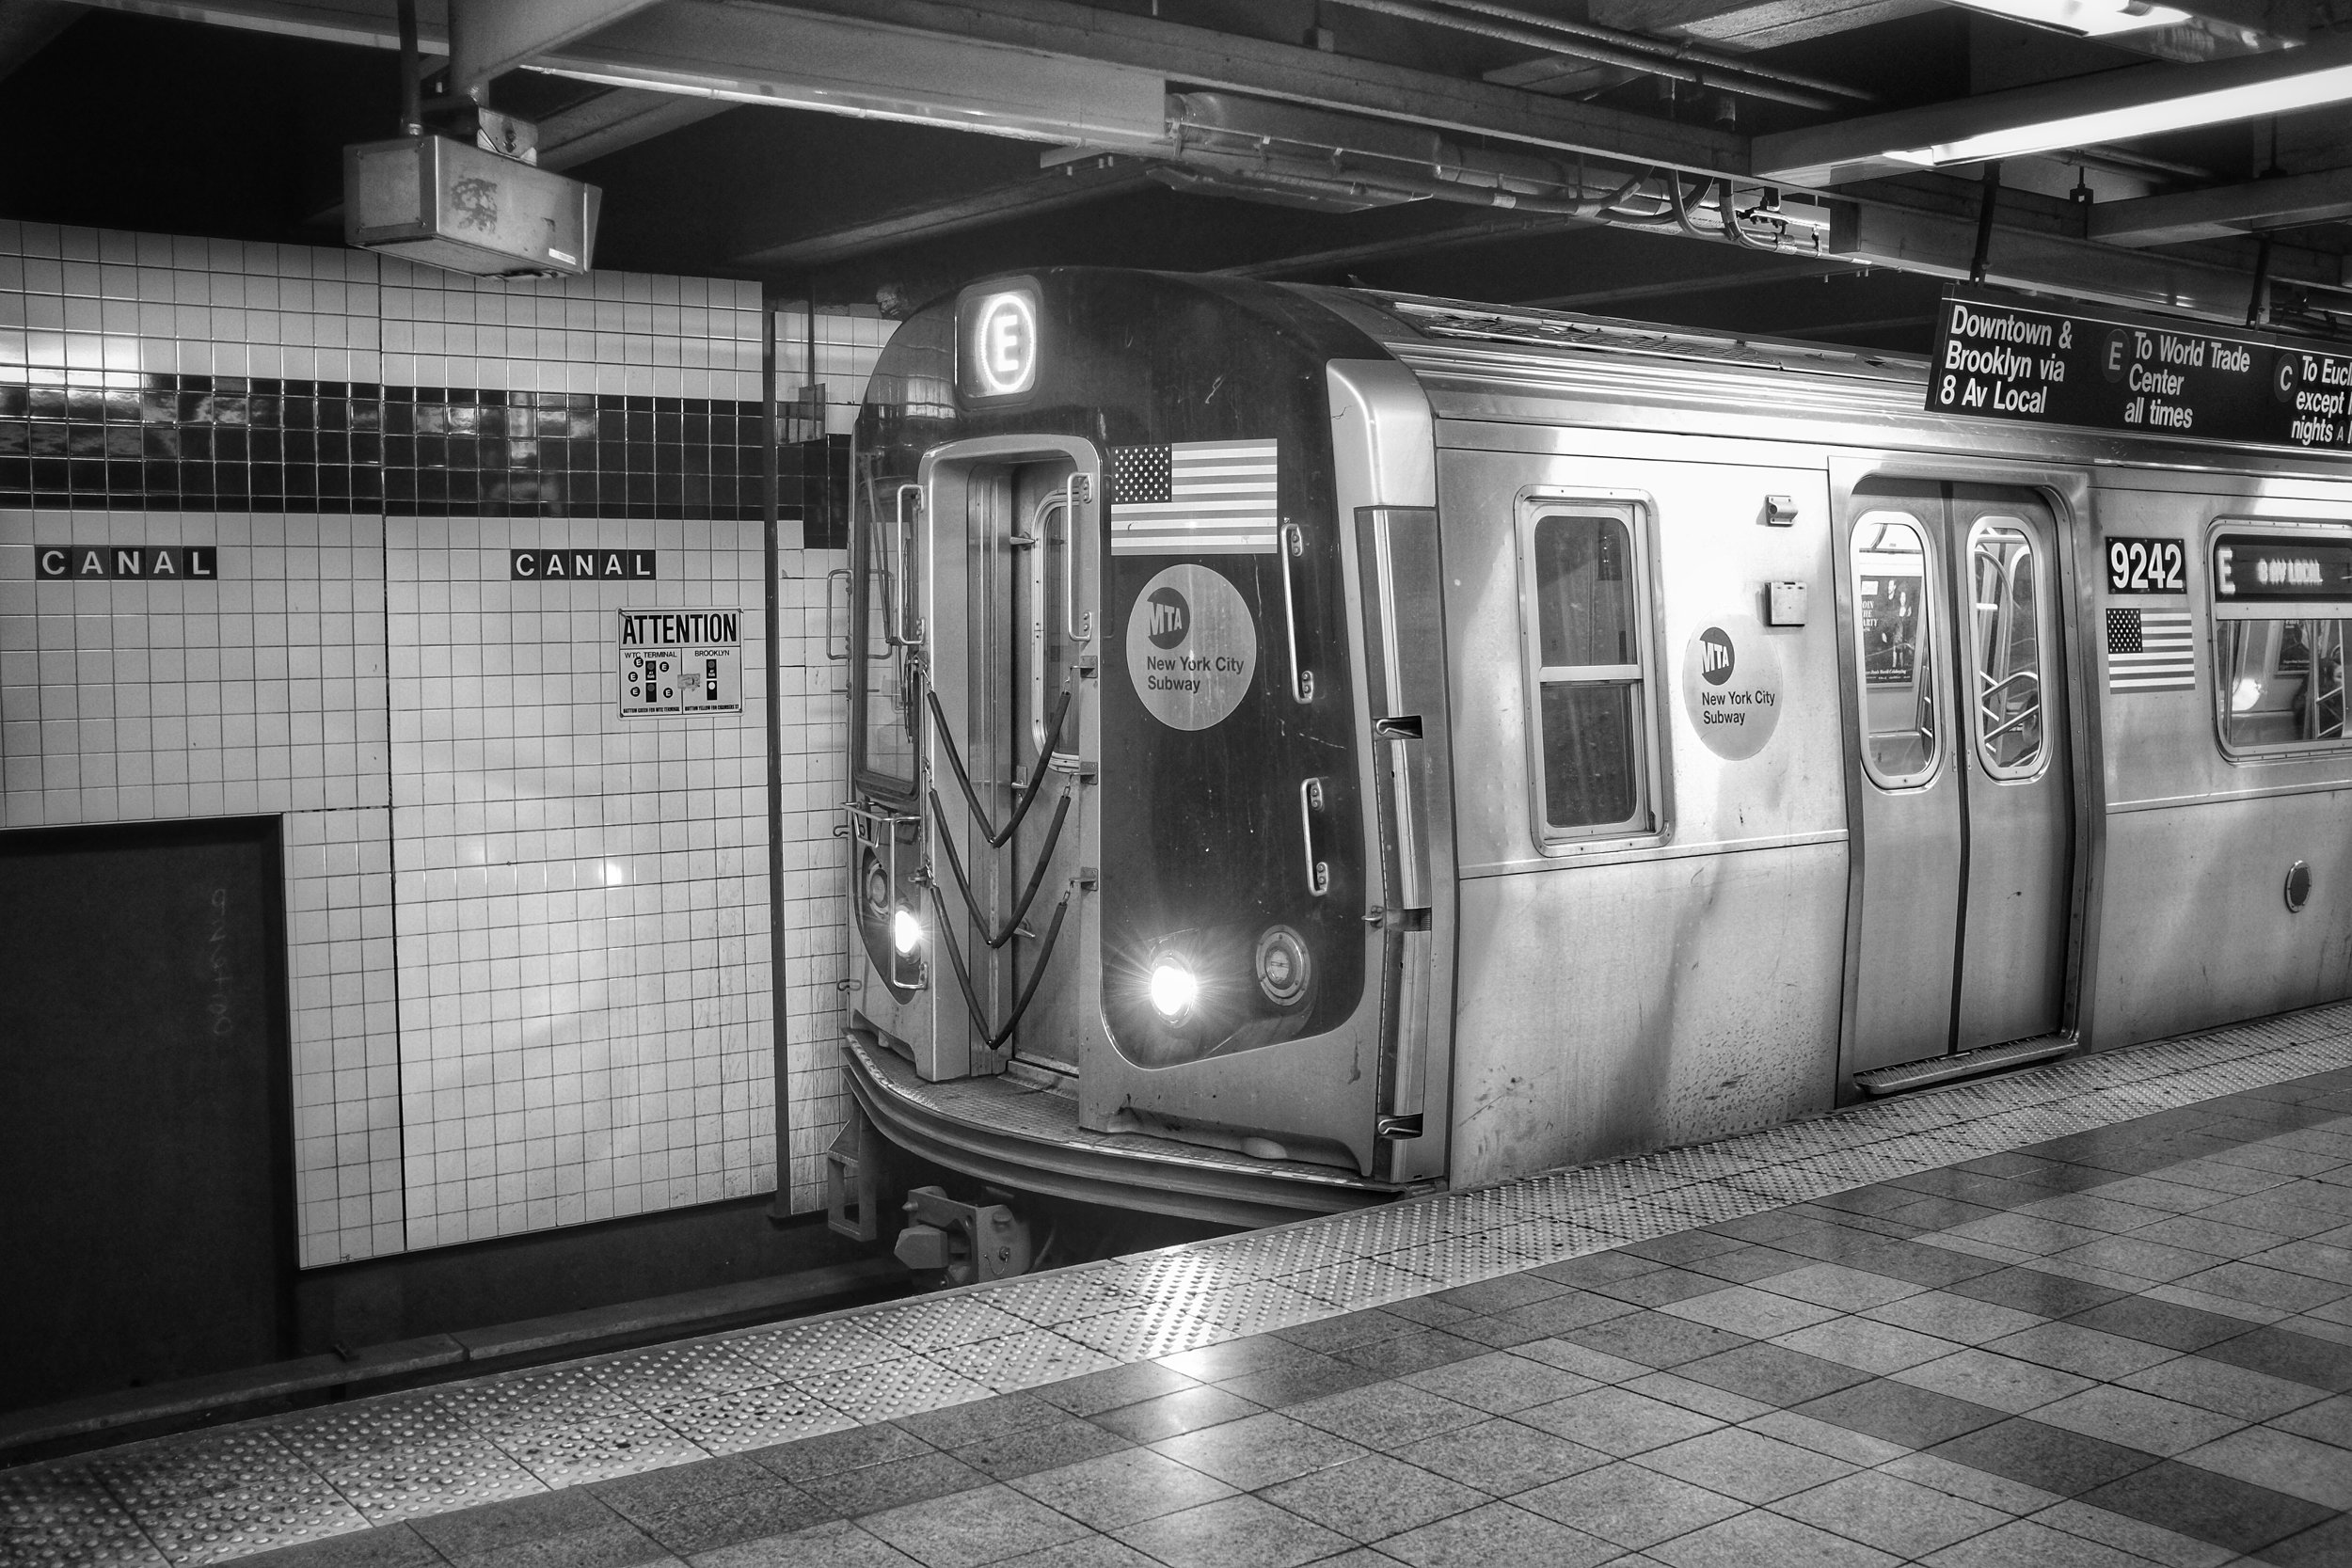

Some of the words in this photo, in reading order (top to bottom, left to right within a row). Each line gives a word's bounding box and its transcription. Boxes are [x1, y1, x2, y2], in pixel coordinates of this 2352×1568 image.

[1950, 304, 2053, 349] Downtown
[2058, 320, 2072, 349] &
[995, 314, 1019, 372] E
[2108, 341, 2123, 371] E
[2134, 331, 2153, 360] To
[2159, 335, 2204, 368] World
[2210, 341, 2250, 373] Trade
[1945, 340, 2033, 381] Brooklyn
[2040, 353, 2065, 382] via
[2280, 365, 2293, 391] C
[2302, 355, 2318, 382] To
[1940, 374, 1955, 405] 8
[1962, 380, 1987, 408] Av
[1994, 386, 2047, 414] Local
[2129, 366, 2185, 396] Center
[2124, 399, 2145, 424] all
[2150, 400, 2193, 428] times
[2296, 390, 2345, 419] except
[2291, 415, 2333, 446] nights
[2336, 426, 2344, 442] A
[42, 550, 210, 575] CANAL
[516, 554, 650, 576] CANAL
[2110, 542, 2184, 589] 9242
[2217, 546, 2235, 594] E
[1147, 600, 1183, 636] MTA
[1862, 600, 1874, 609] OIN
[623, 613, 737, 644] ATTENTION
[1147, 656, 1176, 671] New
[1179, 657, 1211, 672] York
[1216, 656, 1244, 674] City
[1699, 640, 1729, 674] MTA
[1148, 675, 1200, 694] Subway
[1702, 692, 1725, 705] New
[1727, 691, 1752, 705] York
[1755, 689, 1775, 706] City
[1703, 710, 1745, 725] Subway
